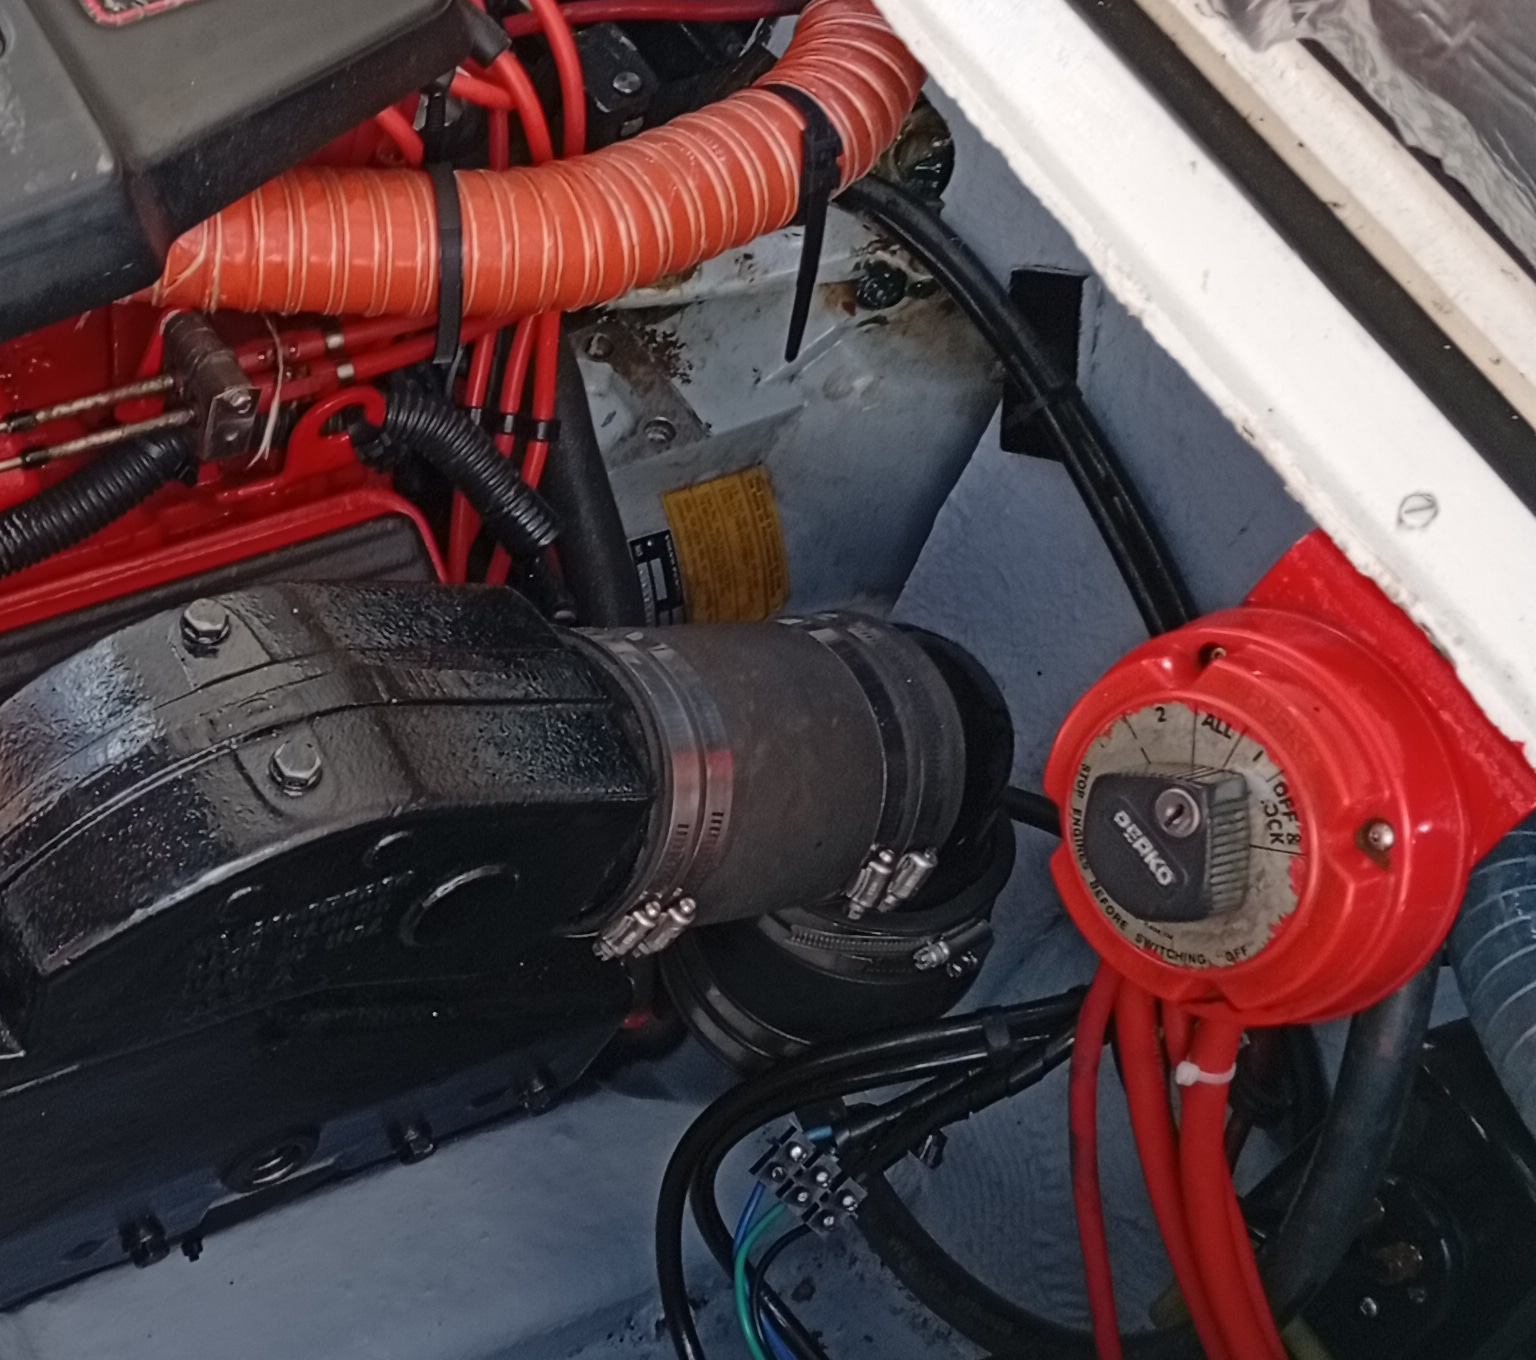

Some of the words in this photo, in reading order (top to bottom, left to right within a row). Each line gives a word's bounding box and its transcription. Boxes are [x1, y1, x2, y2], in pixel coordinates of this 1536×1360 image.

[1155, 706, 1167, 723] 2
[1202, 713, 1233, 739] ALL
[1261, 800, 1285, 845] OCK
[1076, 763, 1092, 799] STOP
[1135, 933, 1207, 965] SWITCHING
[1114, 810, 1176, 887] PERKO
